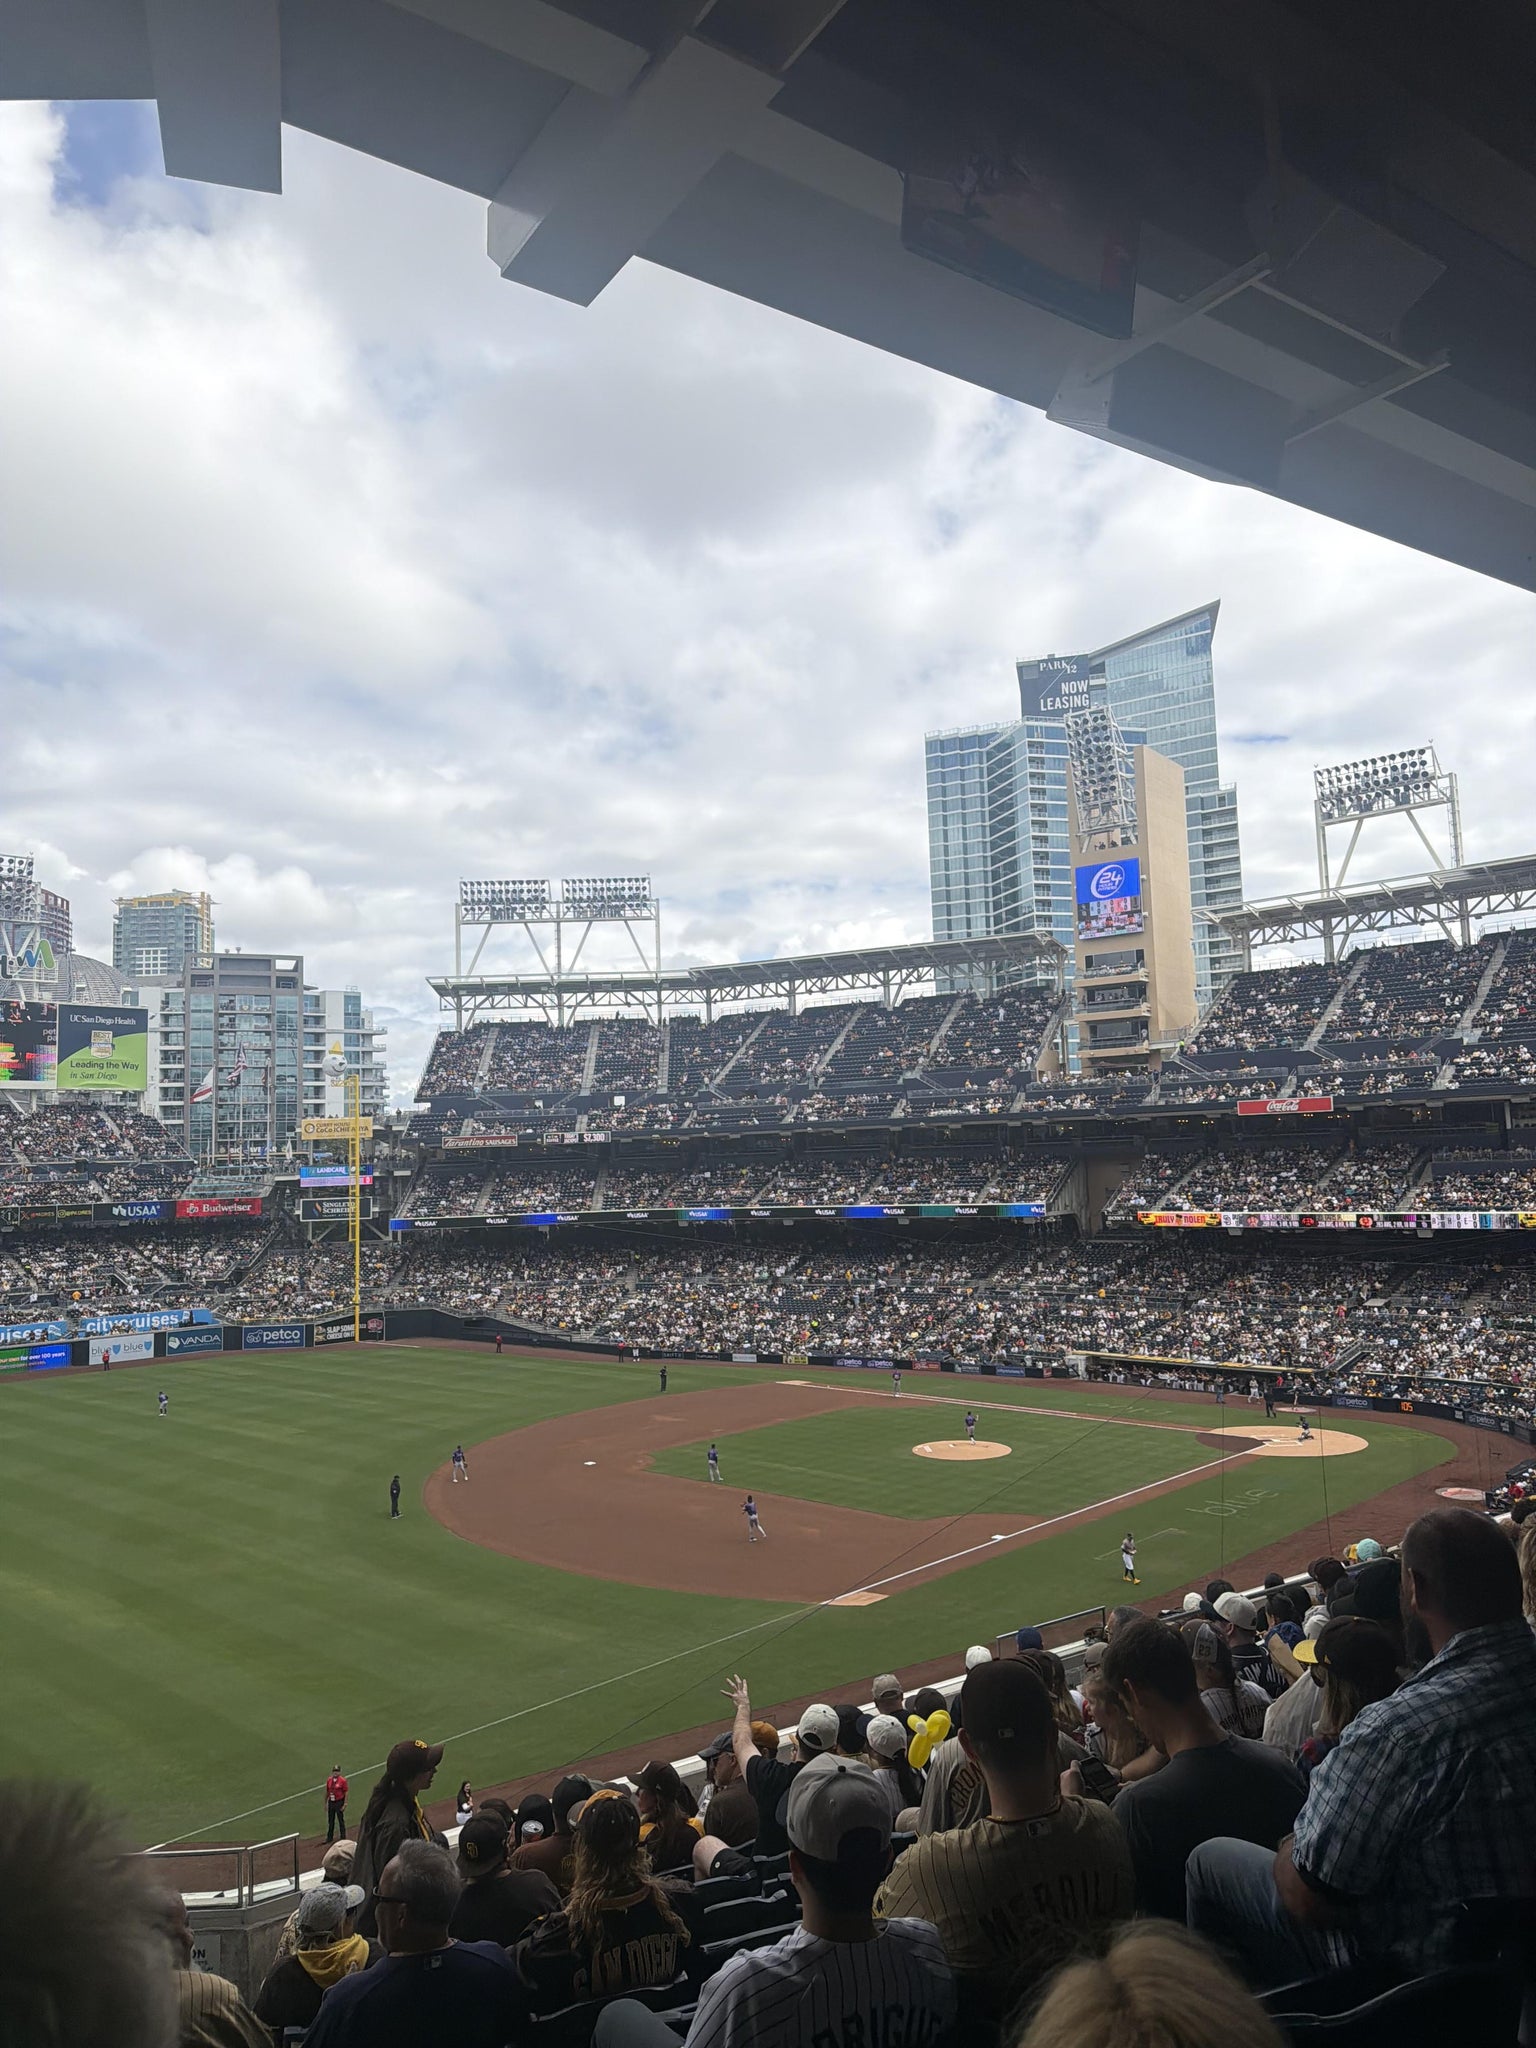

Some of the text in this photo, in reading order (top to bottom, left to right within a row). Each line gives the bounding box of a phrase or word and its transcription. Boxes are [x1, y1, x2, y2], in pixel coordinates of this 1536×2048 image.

[1039, 660, 1078, 674] PARK 12
[1061, 680, 1089, 695] NOW
[1040, 694, 1090, 711] LEASING
[1099, 870, 1123, 886] 24
[70, 1014, 136, 1025] UC San Diego Health
[70, 1060, 139, 1071] Leading the Way
[70, 1071, 118, 1081] in San Diego
[444, 1138, 516, 1147] Tarantino SAUSAGES
[583, 1133, 605, 1142] $7,300
[127, 1205, 158, 1216] USAA
[202, 1203, 252, 1213] Budweiser
[1155, 1215, 1205, 1224] TRULY NOLEN
[263, 1328, 300, 1343] petco
[326, 1326, 340, 1334] SLAP
[180, 1334, 221, 1345] VANDA
[326, 1332, 343, 1340] CHEESE
[92, 1345, 111, 1355] blue
[123, 1342, 143, 1352] blue
[1346, 1397, 1368, 1406] petco
[1476, 1415, 1495, 1425] petco
[1198, 1643, 1211, 1657] 23
[950, 1761, 985, 1809] CRON
[625, 1932, 679, 1985] DIEGO
